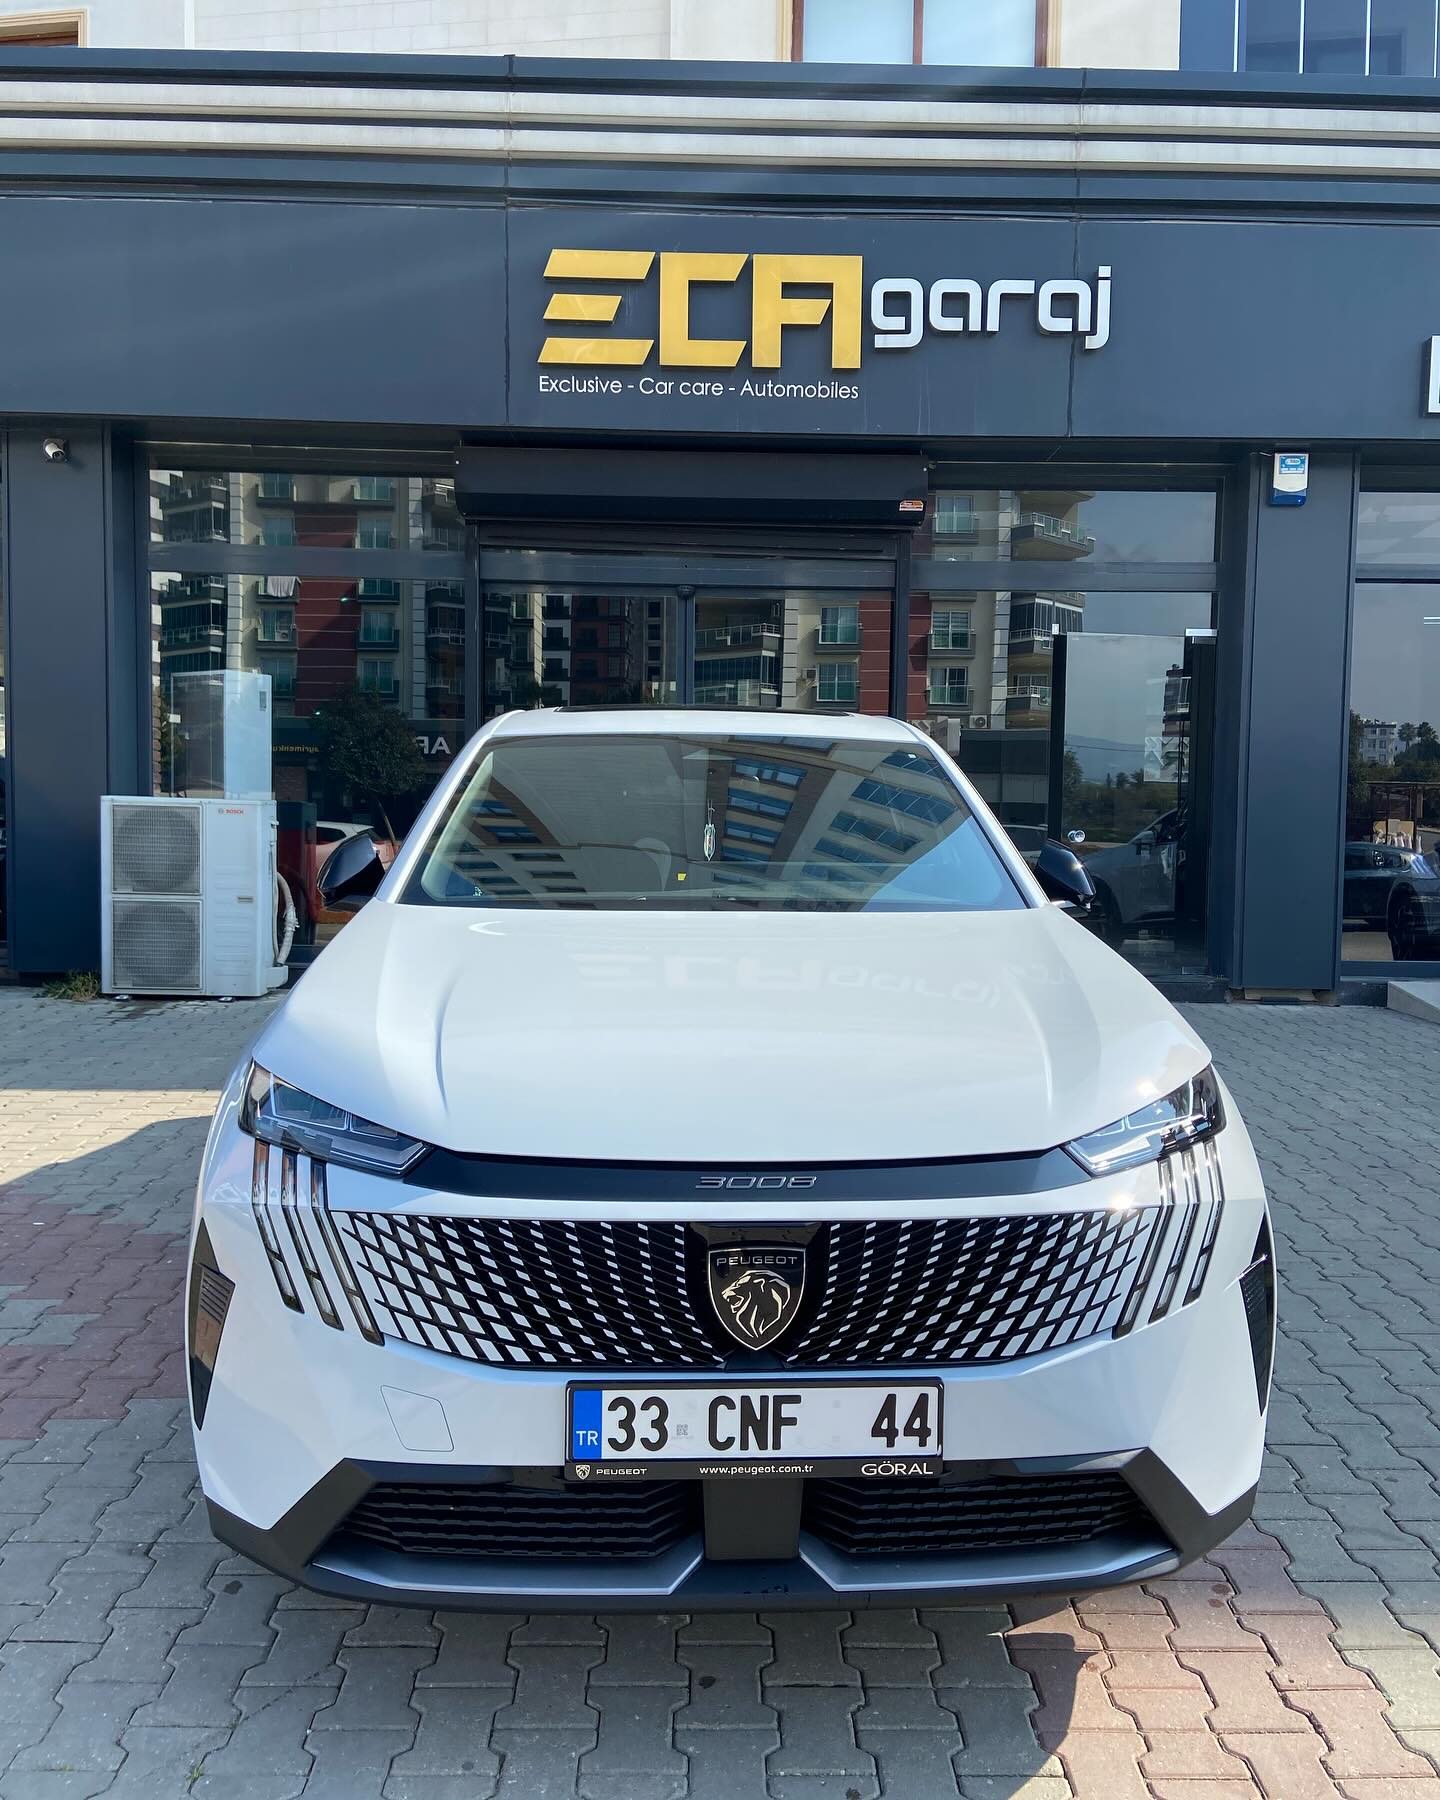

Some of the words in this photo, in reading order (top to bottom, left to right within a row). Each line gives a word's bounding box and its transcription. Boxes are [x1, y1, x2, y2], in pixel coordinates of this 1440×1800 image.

[538, 248, 863, 369] ECA
[869, 264, 1112, 351] garaj
[538, 375, 623, 395] Exclusive
[639, 377, 675, 395] Car
[679, 381, 724, 396] care
[739, 379, 859, 399] Automobiles
[695, 1175, 818, 1190] 3008
[716, 1255, 798, 1267] PEUGEOT
[607, 1395, 669, 1452] 33
[708, 1393, 802, 1451] CNF
[870, 1392, 933, 1449] 44
[575, 1429, 599, 1447] TR
[596, 1467, 648, 1476] PEUGEOT
[699, 1463, 814, 1476] www.peugeot.com.tr
[860, 1460, 934, 1476] GÖRAL
